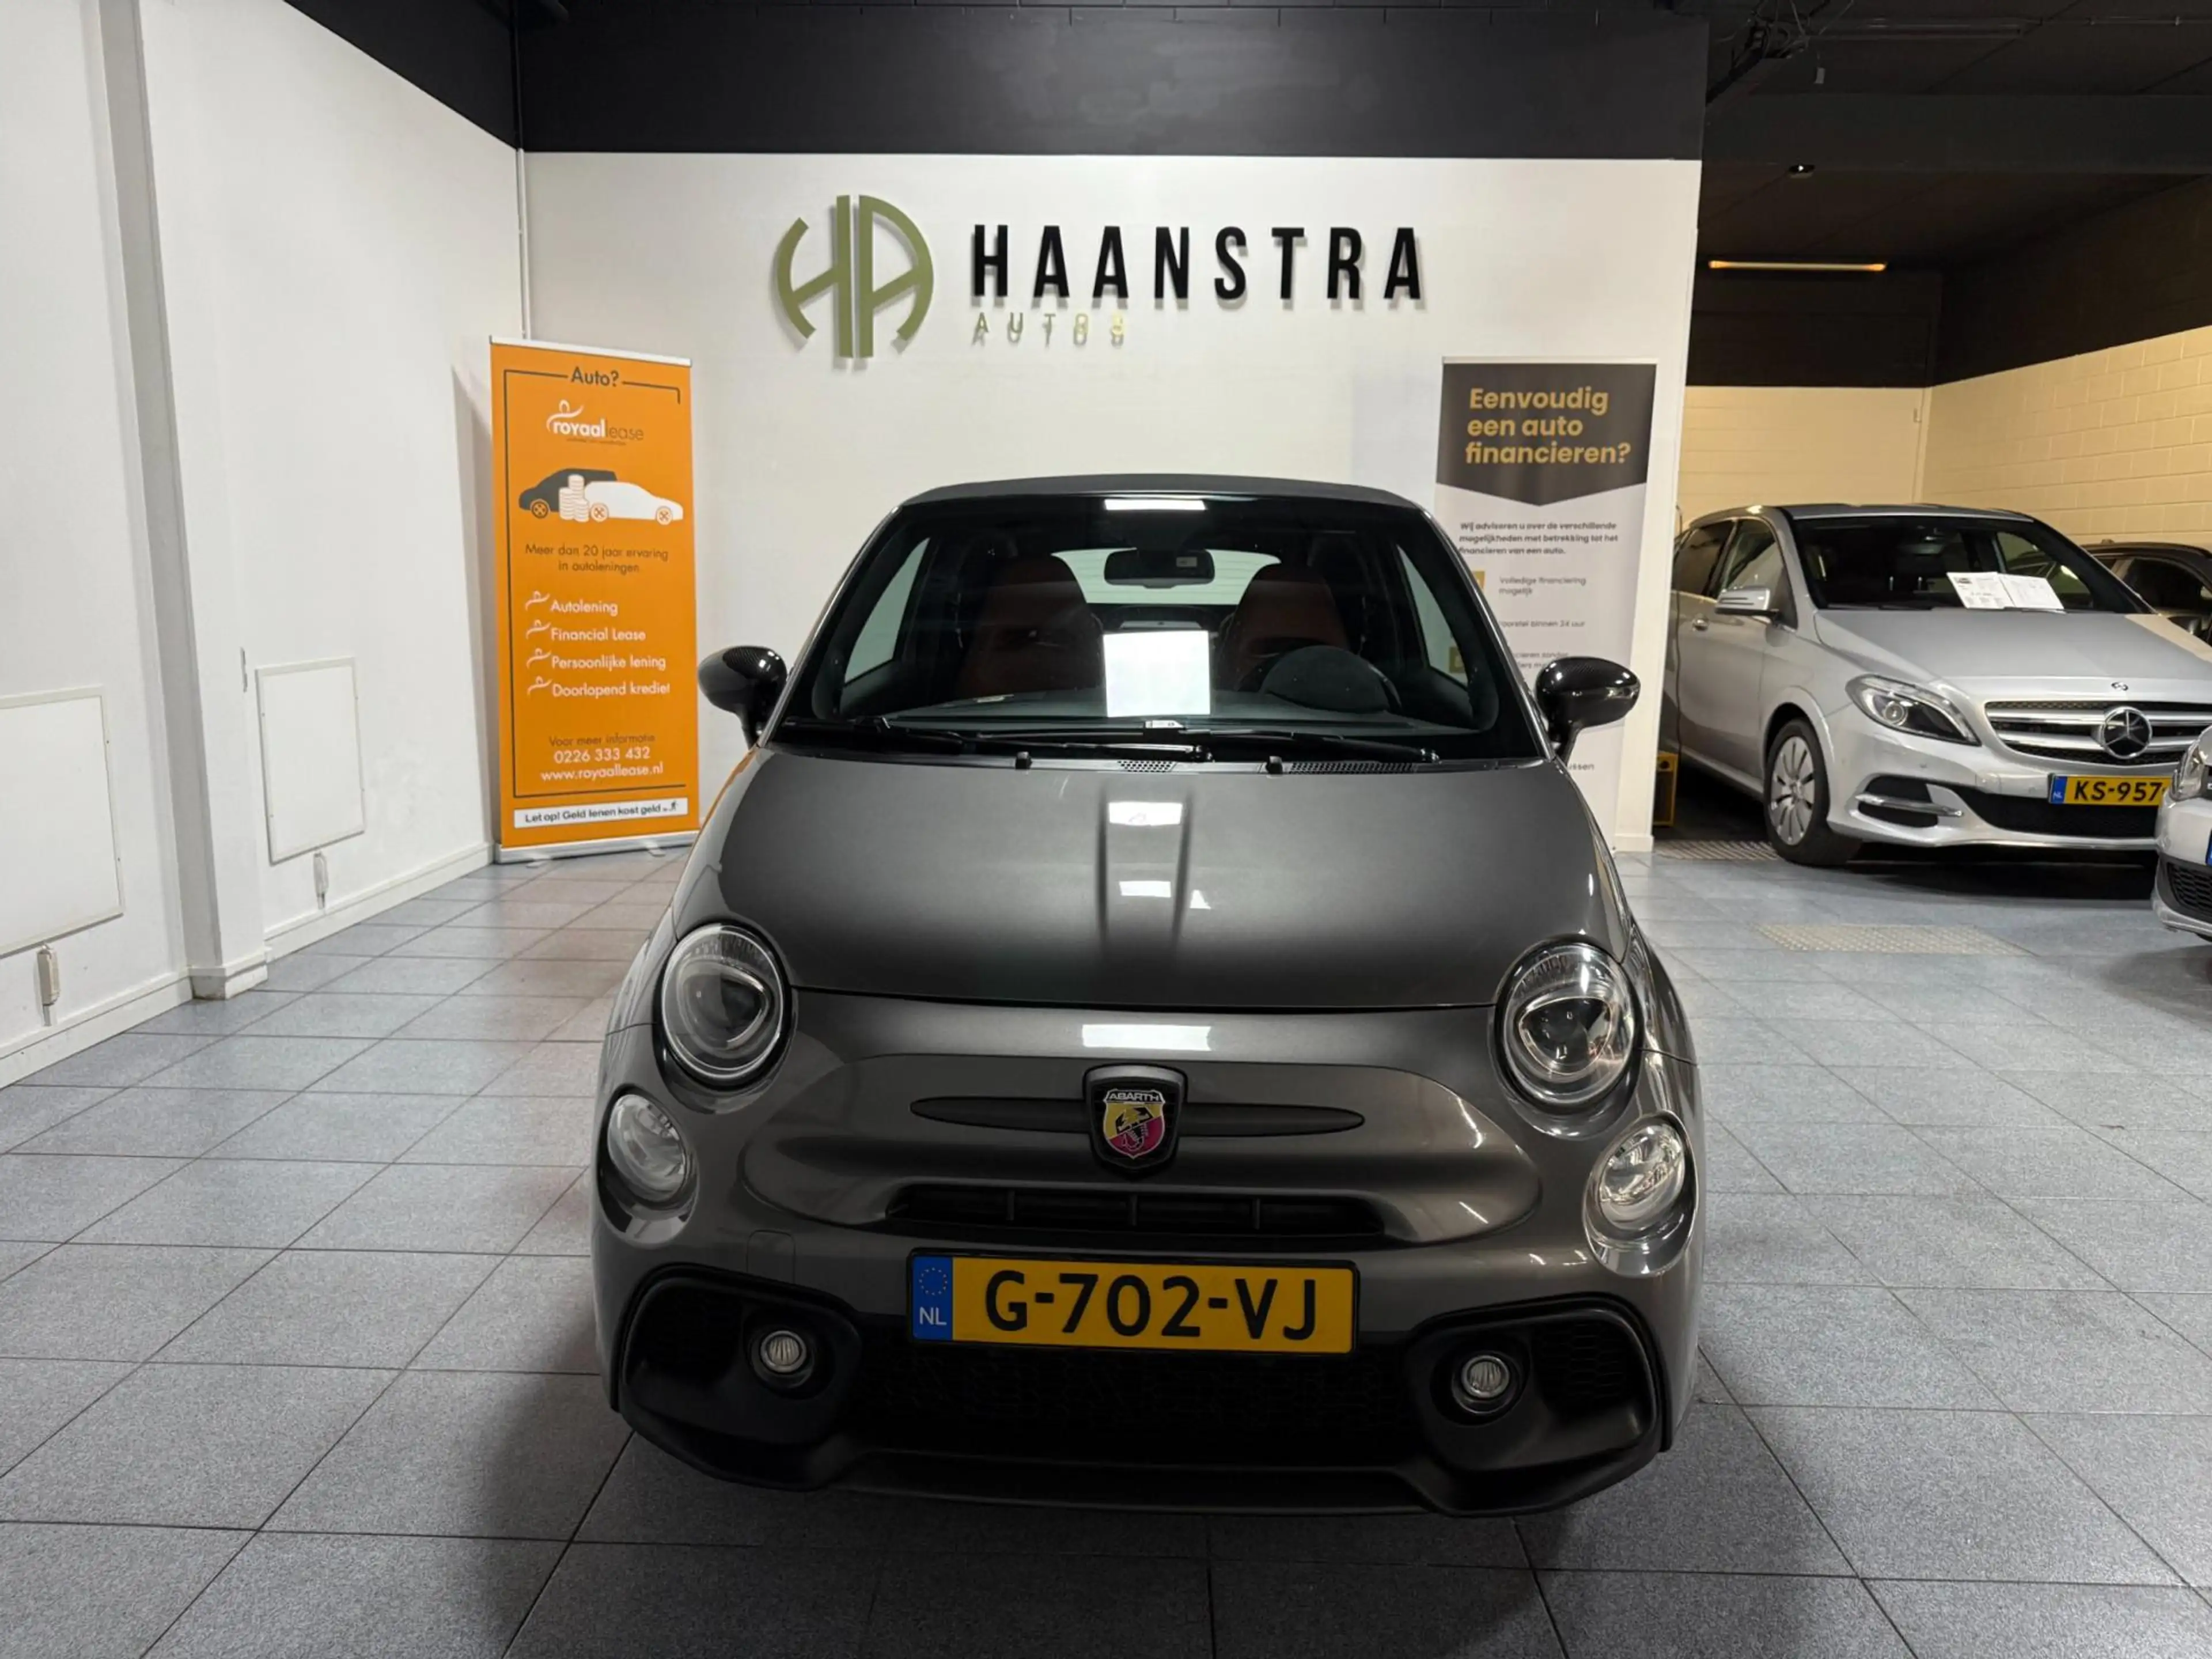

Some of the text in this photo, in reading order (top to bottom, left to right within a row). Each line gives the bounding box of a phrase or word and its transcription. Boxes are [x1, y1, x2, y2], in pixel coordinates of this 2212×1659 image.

[974, 225, 1421, 300] HAANSTRA
[571, 366, 619, 387] Auto?
[1469, 386, 1609, 416] Eenvoudig
[1467, 416, 1583, 436] een auto
[1465, 441, 1631, 464] financieren?
[1460, 522, 1474, 532] Wij
[1475, 522, 1517, 531] adviseren
[1547, 522, 1558, 530] de
[1559, 522, 1617, 531] verschillende
[1459, 534, 1618, 545] mogelijkheden met betrekking tot het
[525, 543, 669, 562] Meer dan 20 jaar ervaring
[558, 560, 639, 575] in autoleningen
[551, 599, 619, 617] Autolening
[551, 627, 646, 641] Financial Lease
[551, 655, 666, 672] Persoonlijke lening
[552, 682, 671, 699] Doorlopend krediet
[549, 733, 656, 747] Voor meer informatie
[554, 746, 650, 764] 0226 333 432
[540, 761, 663, 781] www.royaallease.nl
[2074, 780, 2165, 801] KS-957
[525, 804, 661, 824] Let op! Geld lenen kost geld
[1109, 1092, 1160, 1101] ABARTH
[919, 1270, 1316, 1340] NL G-702-VJ
